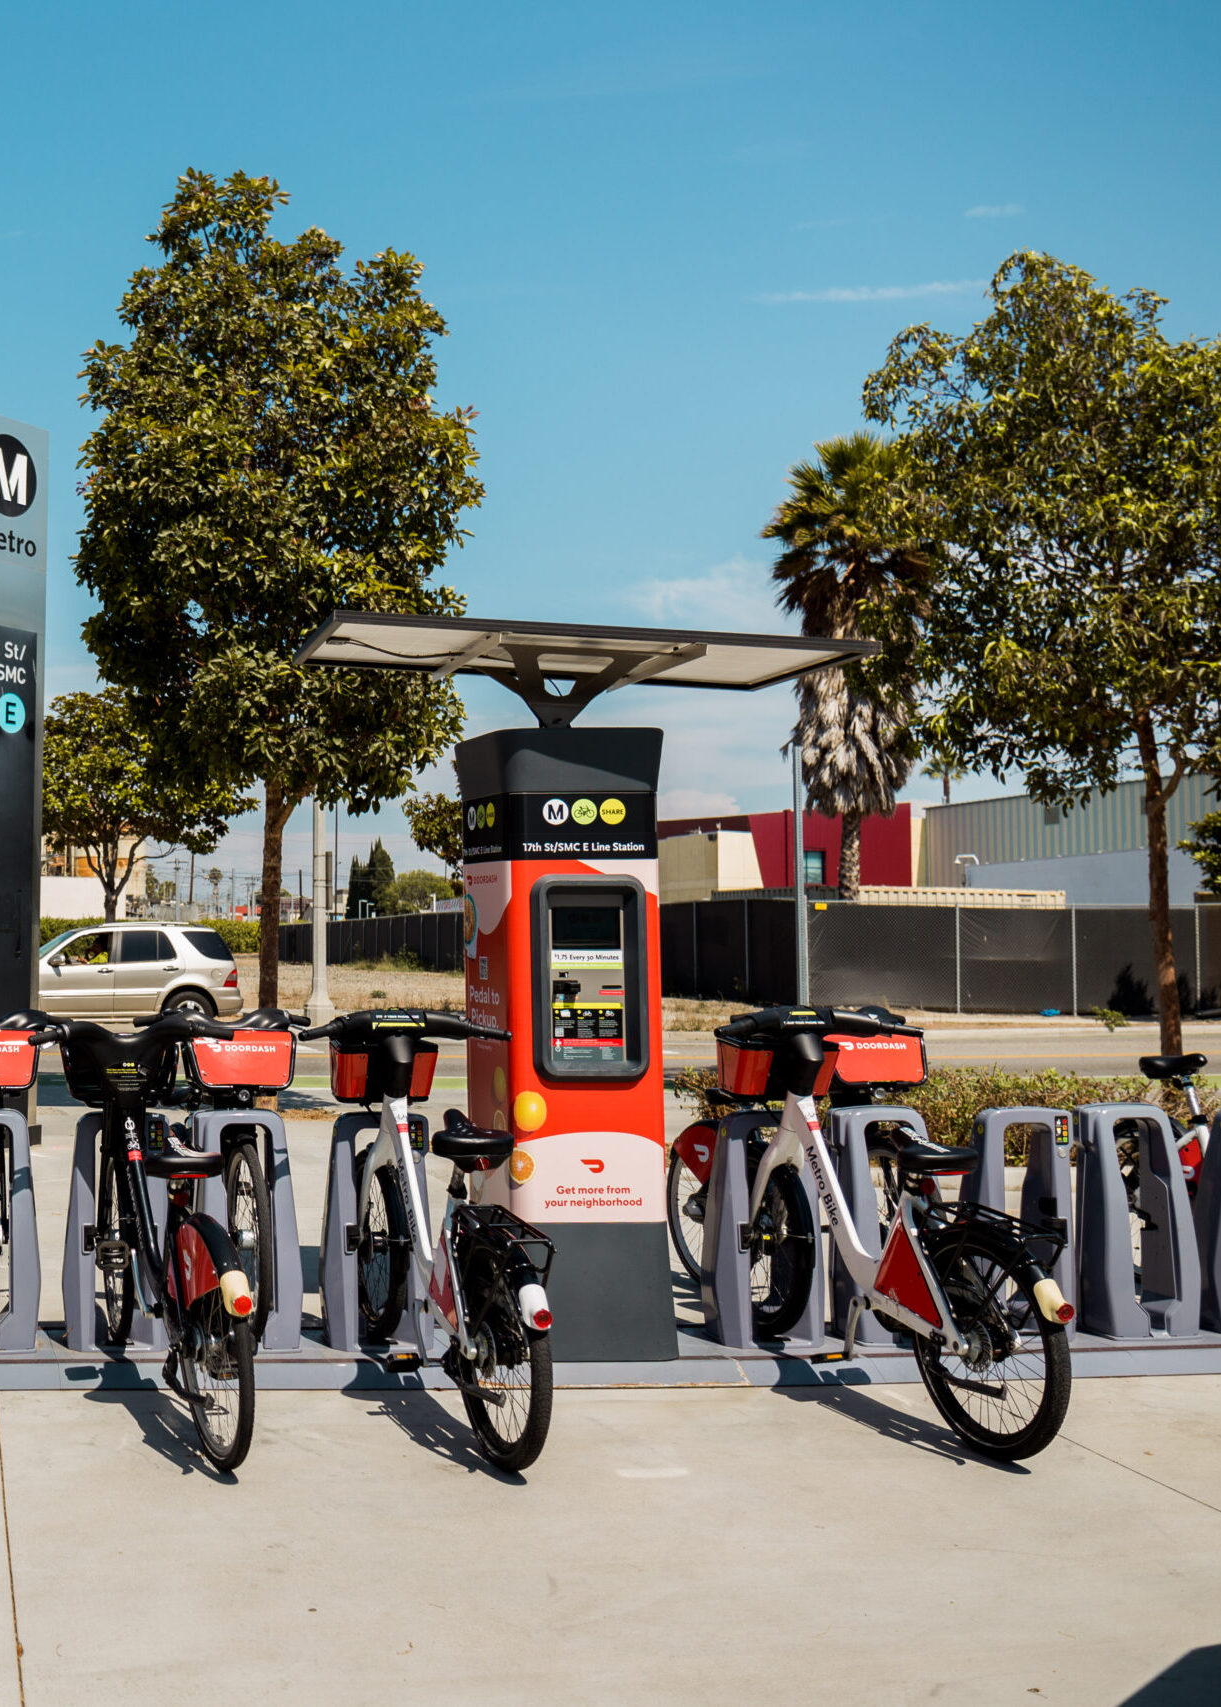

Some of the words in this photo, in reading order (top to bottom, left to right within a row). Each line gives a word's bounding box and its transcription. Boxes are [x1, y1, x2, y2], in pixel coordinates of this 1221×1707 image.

[4, 640, 27, 661] St/
[5, 701, 16, 725] E
[547, 804, 564, 820] M
[601, 808, 624, 816] SHARE
[523, 842, 542, 852] 17th
[544, 842, 581, 853] St/SMC
[583, 843, 589, 852] E
[591, 842, 611, 852] Line
[612, 842, 645, 852] Station
[469, 985, 490, 1004] Pedal
[491, 989, 500, 1005] to
[224, 1044, 276, 1053] DOORDASH
[856, 1042, 907, 1050] DOORDASH
[556, 1185, 576, 1195] Get
[578, 1186, 604, 1195] more
[606, 1185, 631, 1195] from
[805, 1145, 826, 1191] Metro
[823, 1194, 839, 1227] Bike
[397, 1157, 409, 1205] Metro
[408, 1208, 417, 1244] Bike
[544, 1198, 568, 1209] your
[570, 1196, 643, 1209] neighborhood
